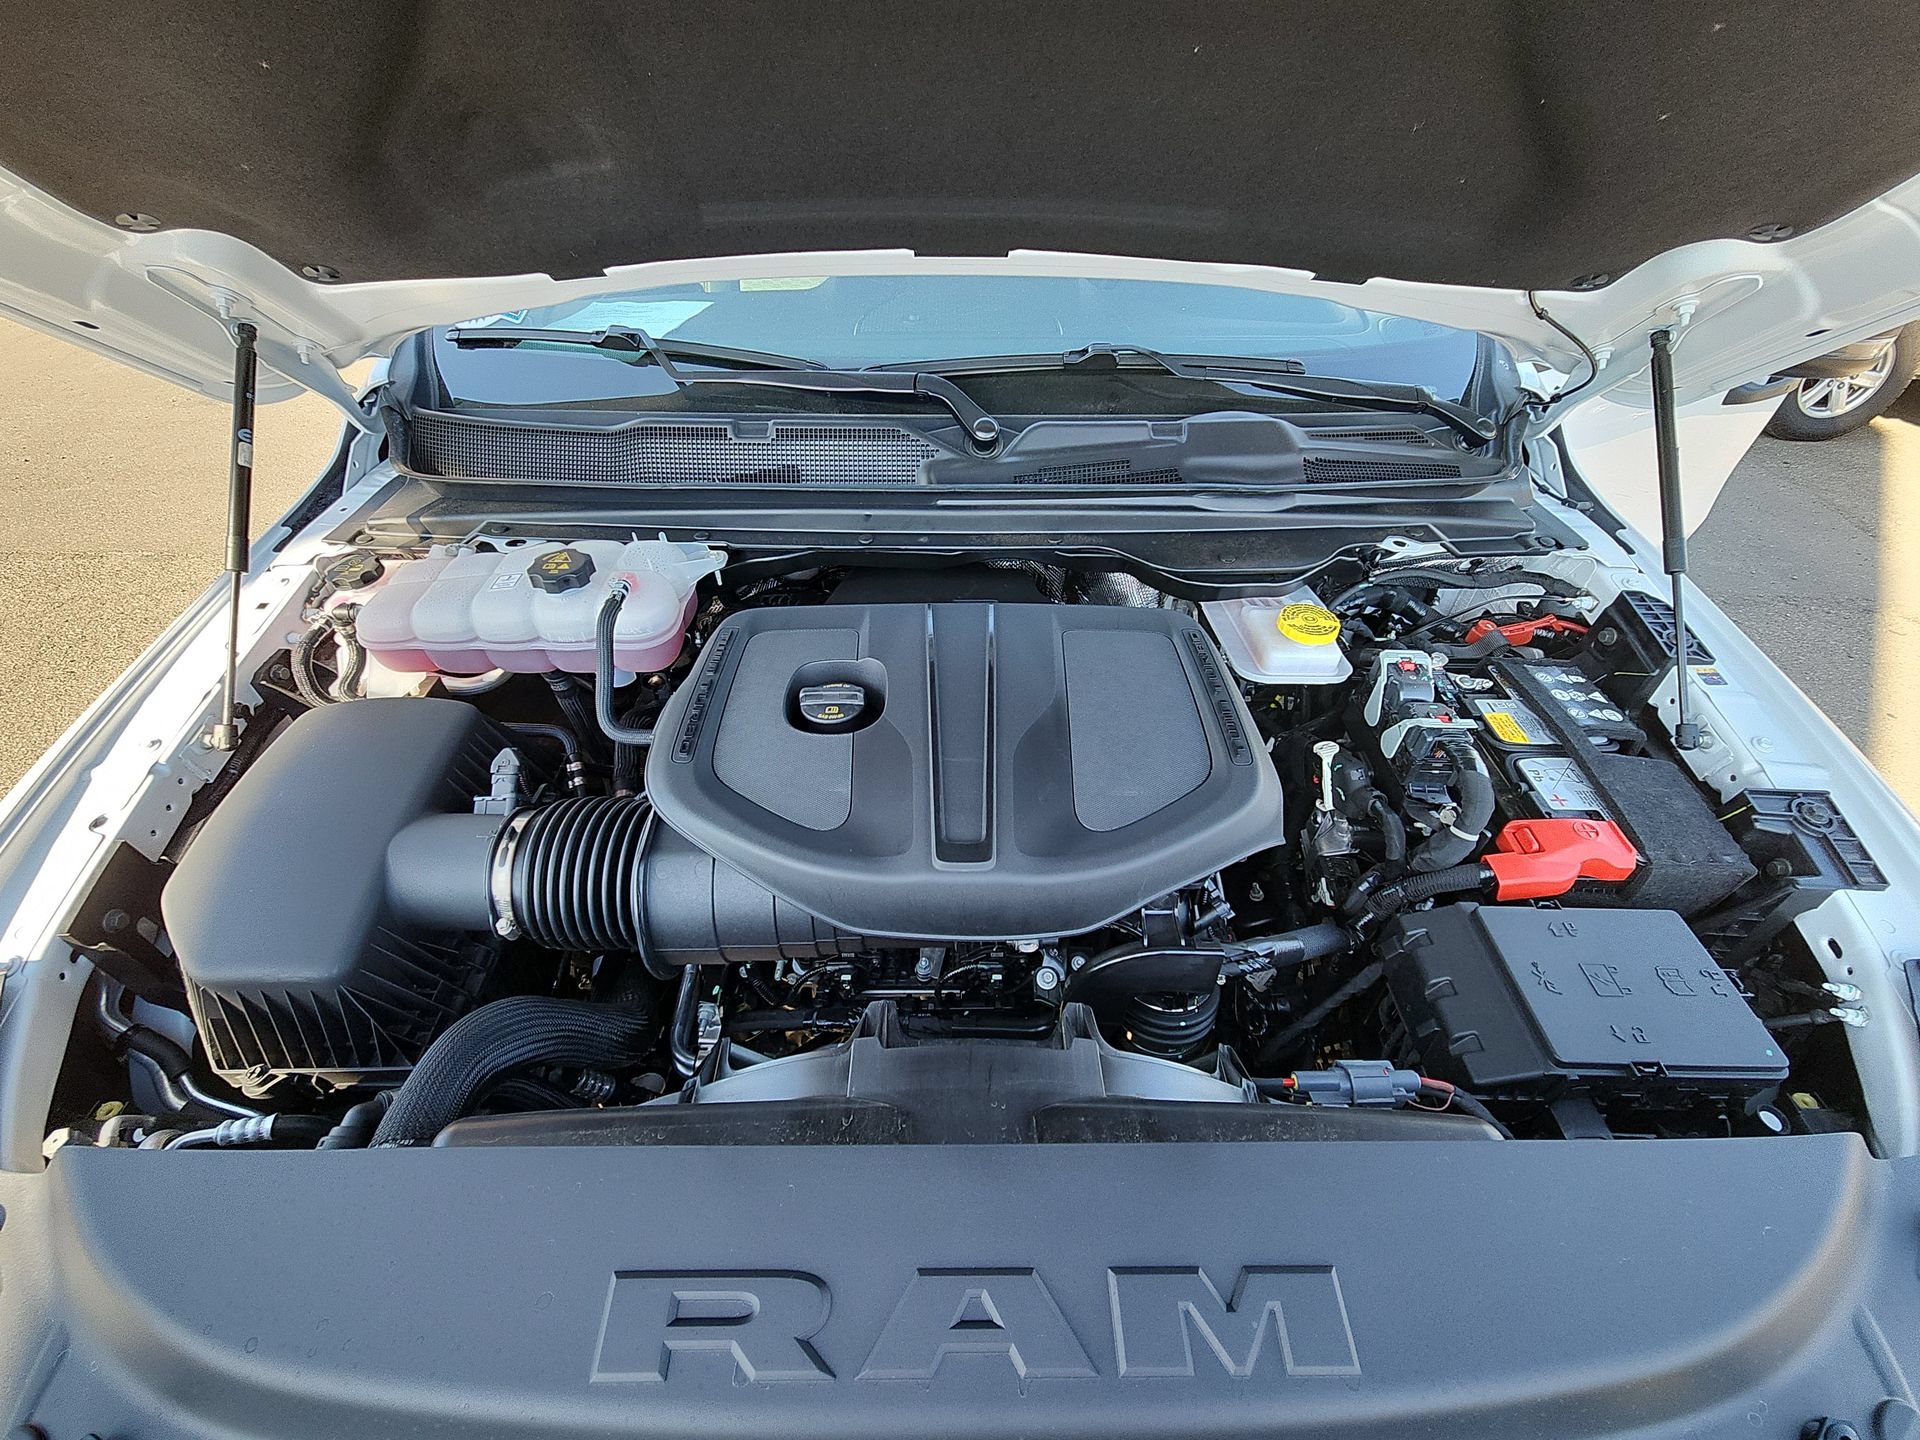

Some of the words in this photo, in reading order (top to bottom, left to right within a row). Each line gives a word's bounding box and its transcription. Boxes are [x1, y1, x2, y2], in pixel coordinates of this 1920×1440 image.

[706, 629, 734, 676] TWIN
[1188, 631, 1223, 696] TURBO
[678, 678, 714, 758] TURBO
[1218, 698, 1247, 758] TWIN
[1527, 768, 1544, 782] Pb
[588, 1264, 1363, 1383] RAM
